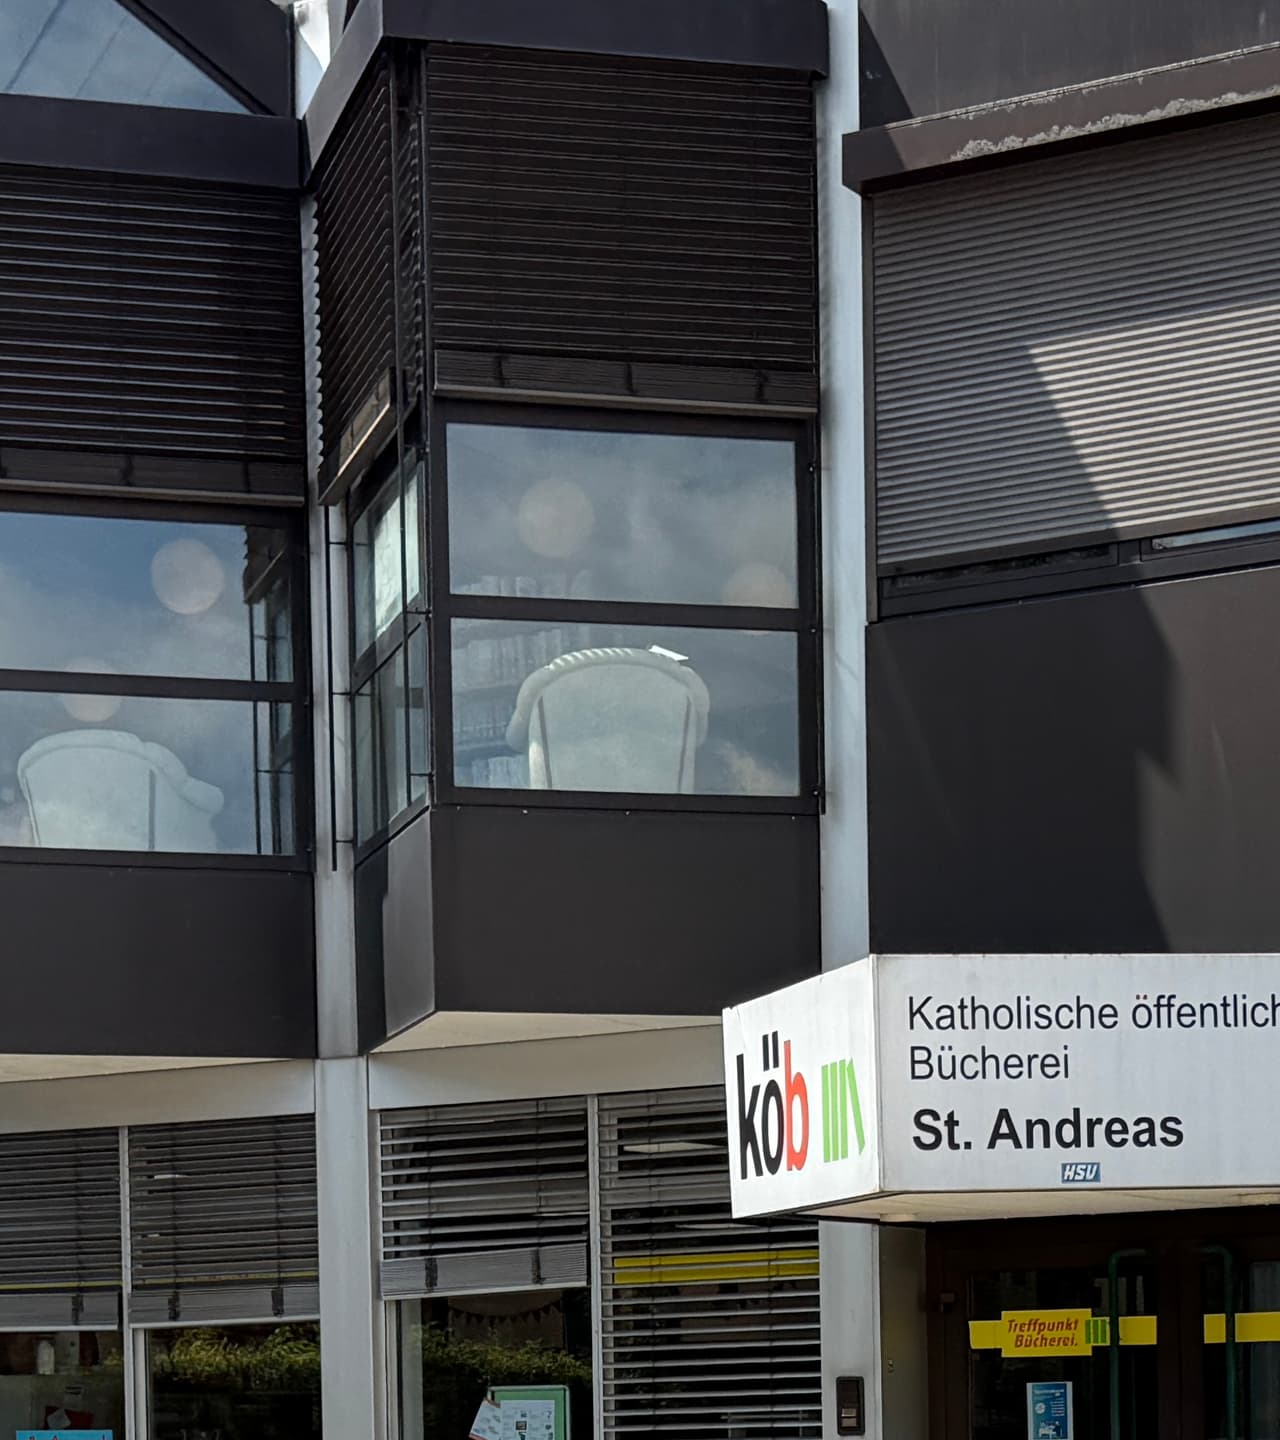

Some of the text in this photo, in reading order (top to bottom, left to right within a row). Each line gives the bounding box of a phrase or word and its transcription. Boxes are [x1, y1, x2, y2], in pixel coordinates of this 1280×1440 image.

[907, 995, 1119, 1032] Katholische
[910, 1045, 1070, 1082] Bücherei
[736, 1030, 810, 1181] köb
[912, 1107, 1185, 1151] St. Andreas
[1063, 1164, 1098, 1181] HSV
[1007, 1318, 1079, 1335] Treffpunkt
[1014, 1333, 1079, 1348] Bücherei.
